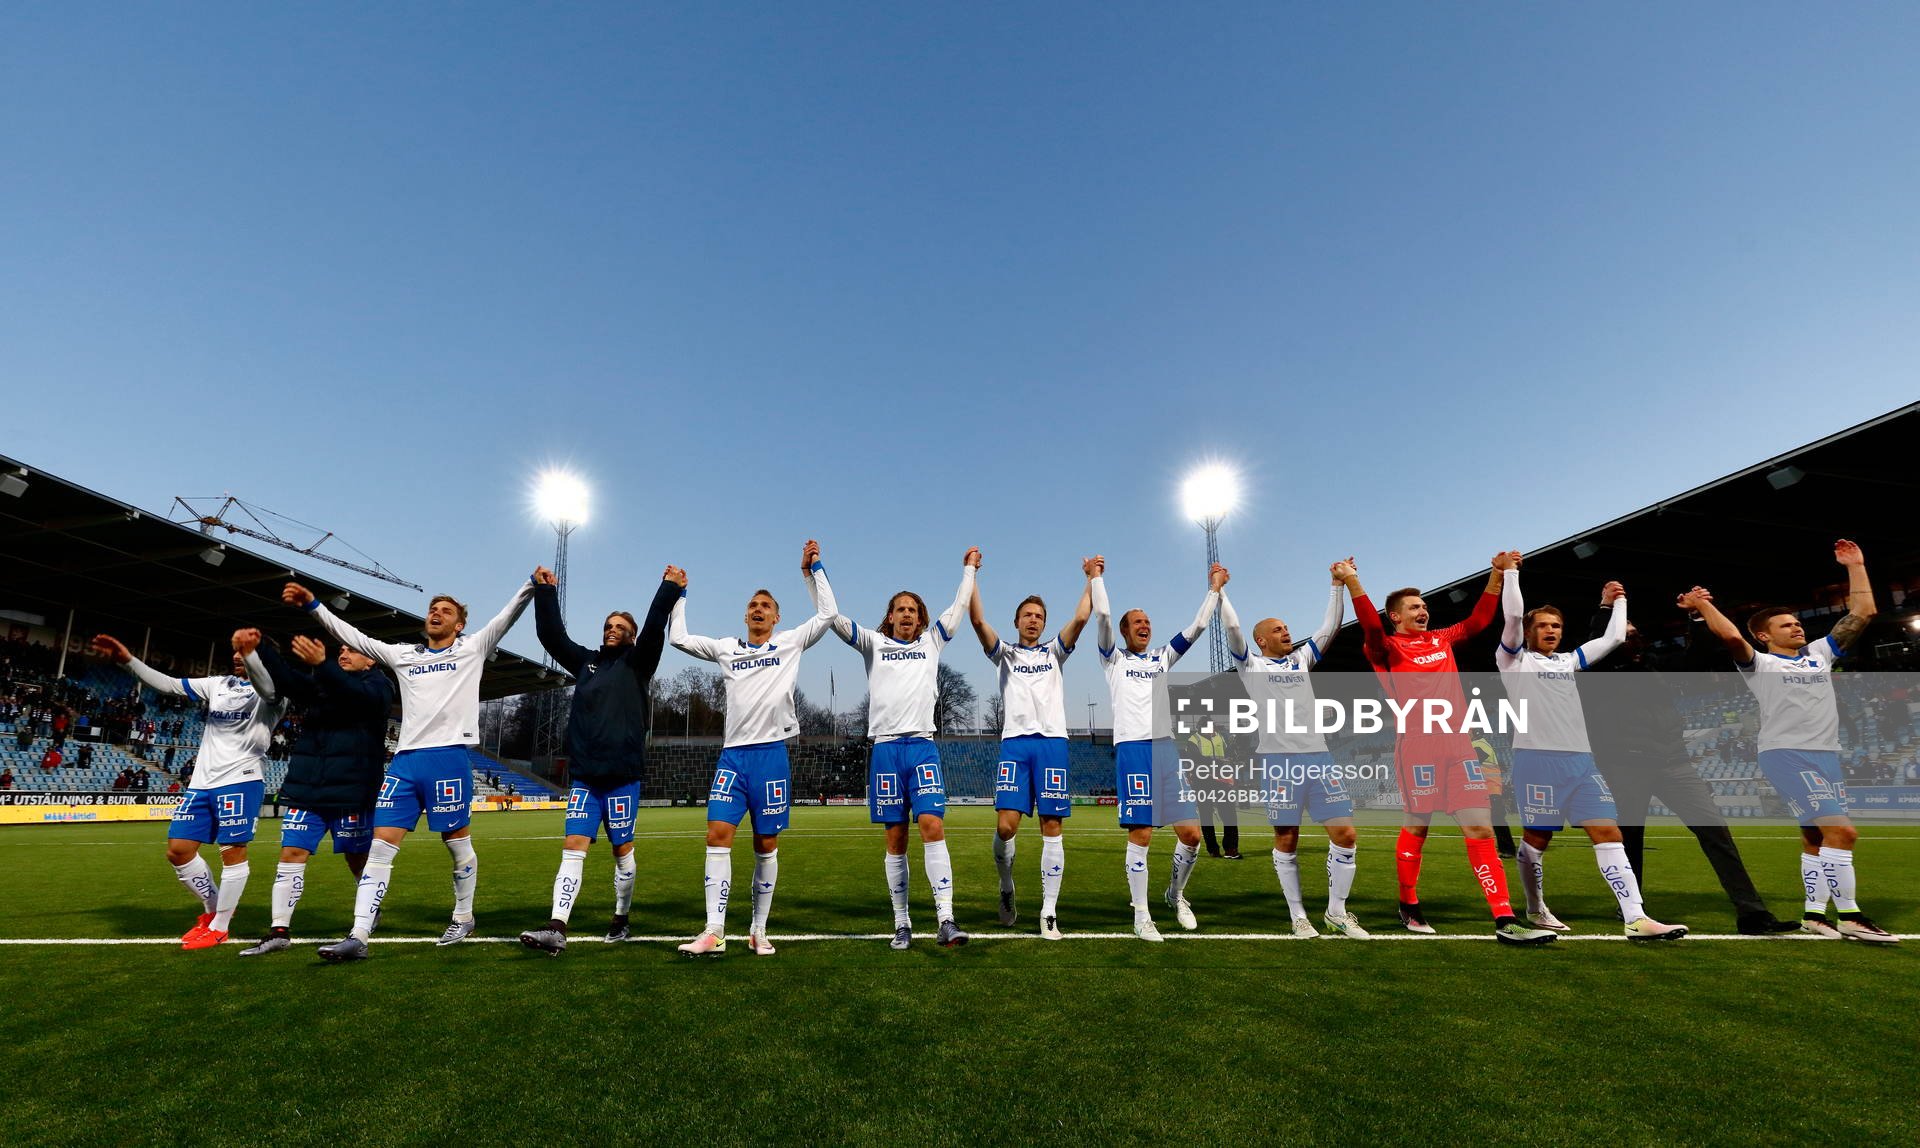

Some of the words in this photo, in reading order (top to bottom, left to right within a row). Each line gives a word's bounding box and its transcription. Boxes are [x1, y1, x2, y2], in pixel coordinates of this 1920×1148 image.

[882, 652, 926, 661] HOLMEN
[408, 663, 457, 676] HOLMEN
[732, 657, 780, 671] HOLMEN
[1013, 663, 1053, 674] HOLMEN
[14, 793, 93, 806] UTSTÄLLNING
[96, 795, 107, 805] &
[108, 795, 138, 805] BUTIK
[1040, 791, 1070, 800] stadium
[432, 803, 465, 813] stadium
[1125, 807, 1133, 818] 4
[1523, 806, 1560, 816] stadium
[1810, 801, 1820, 812] 9
[219, 818, 248, 826] adium
[1524, 813, 1535, 823] 19
[192, 871, 217, 900] suez
[1474, 864, 1498, 896] suez
[1601, 865, 1630, 901] suez
[1804, 870, 1818, 903] suez
[370, 881, 388, 914] suez
[559, 876, 578, 910] suez
